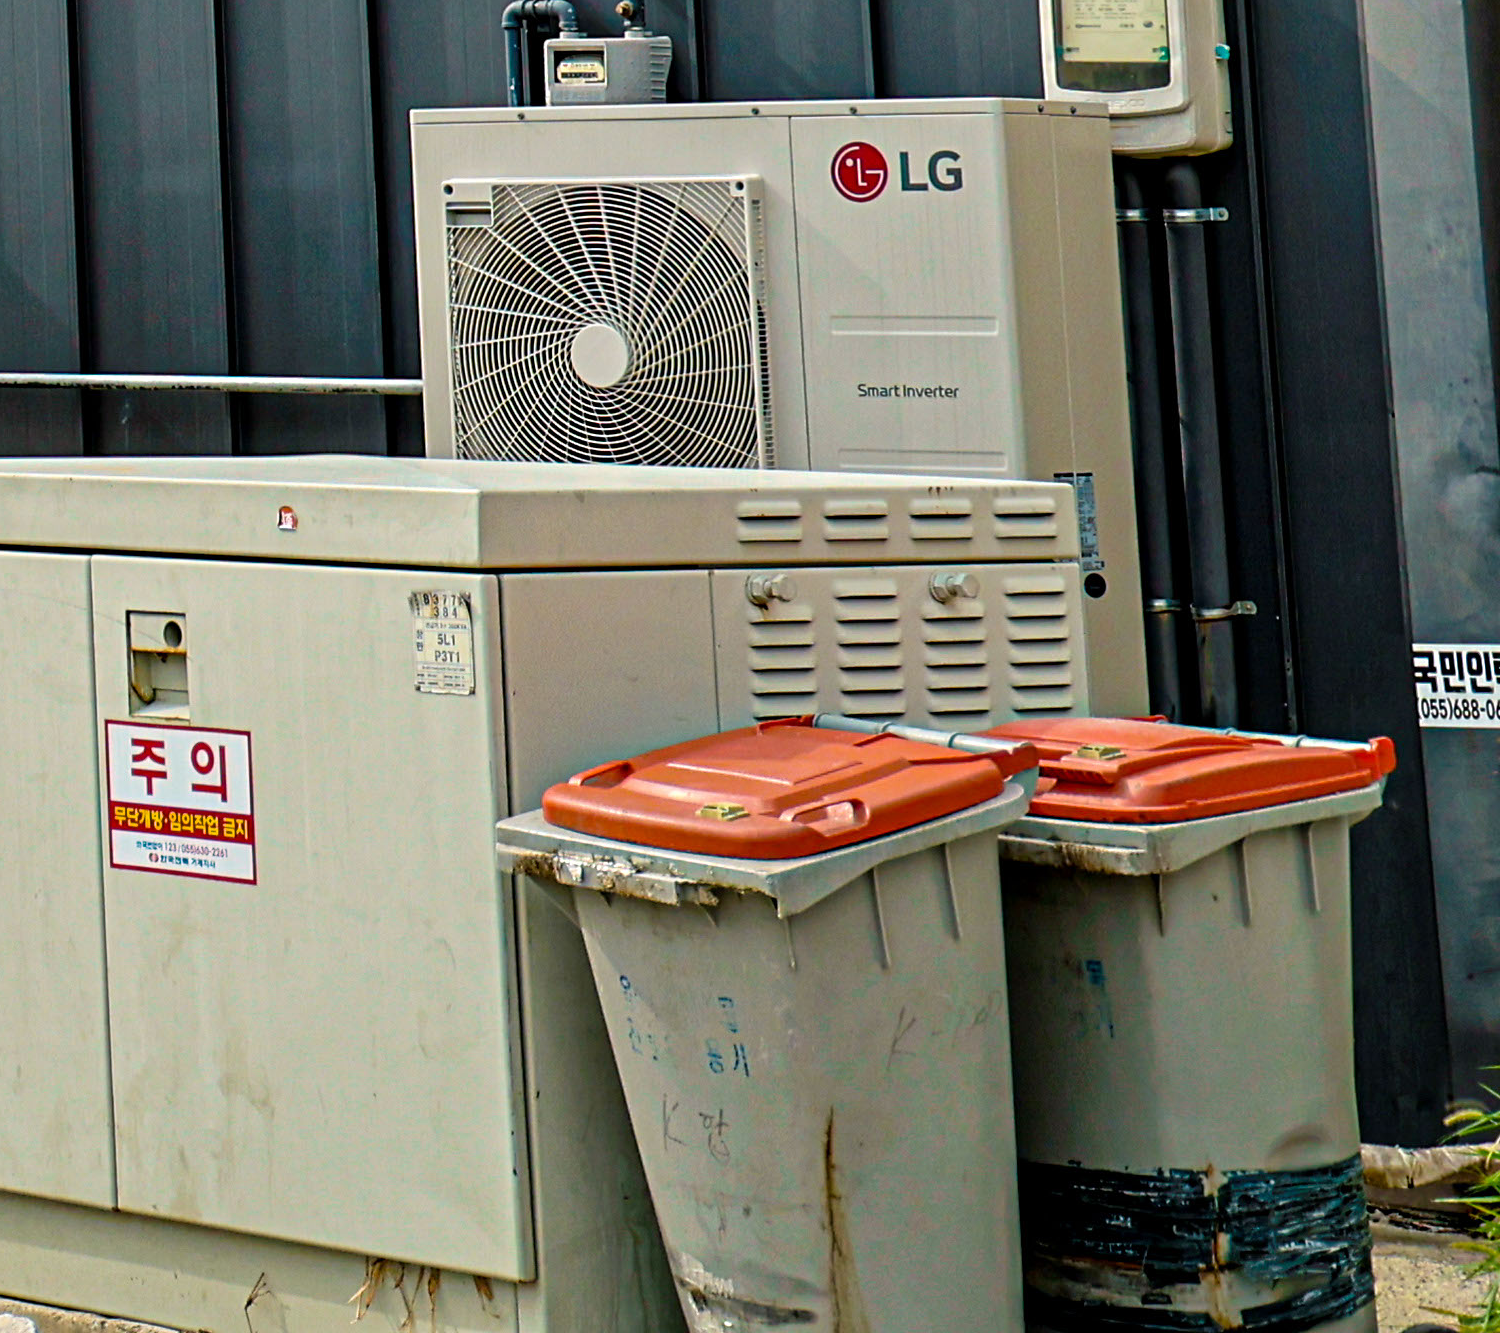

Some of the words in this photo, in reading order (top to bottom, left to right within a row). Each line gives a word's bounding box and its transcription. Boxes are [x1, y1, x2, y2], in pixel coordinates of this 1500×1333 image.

[899, 149, 964, 192] LG
[857, 383, 900, 398] Smart
[903, 384, 959, 399] Inverter
[437, 633, 456, 646] 5L1
[434, 650, 460, 663] P3T1
[222, 816, 248, 840] 금지
